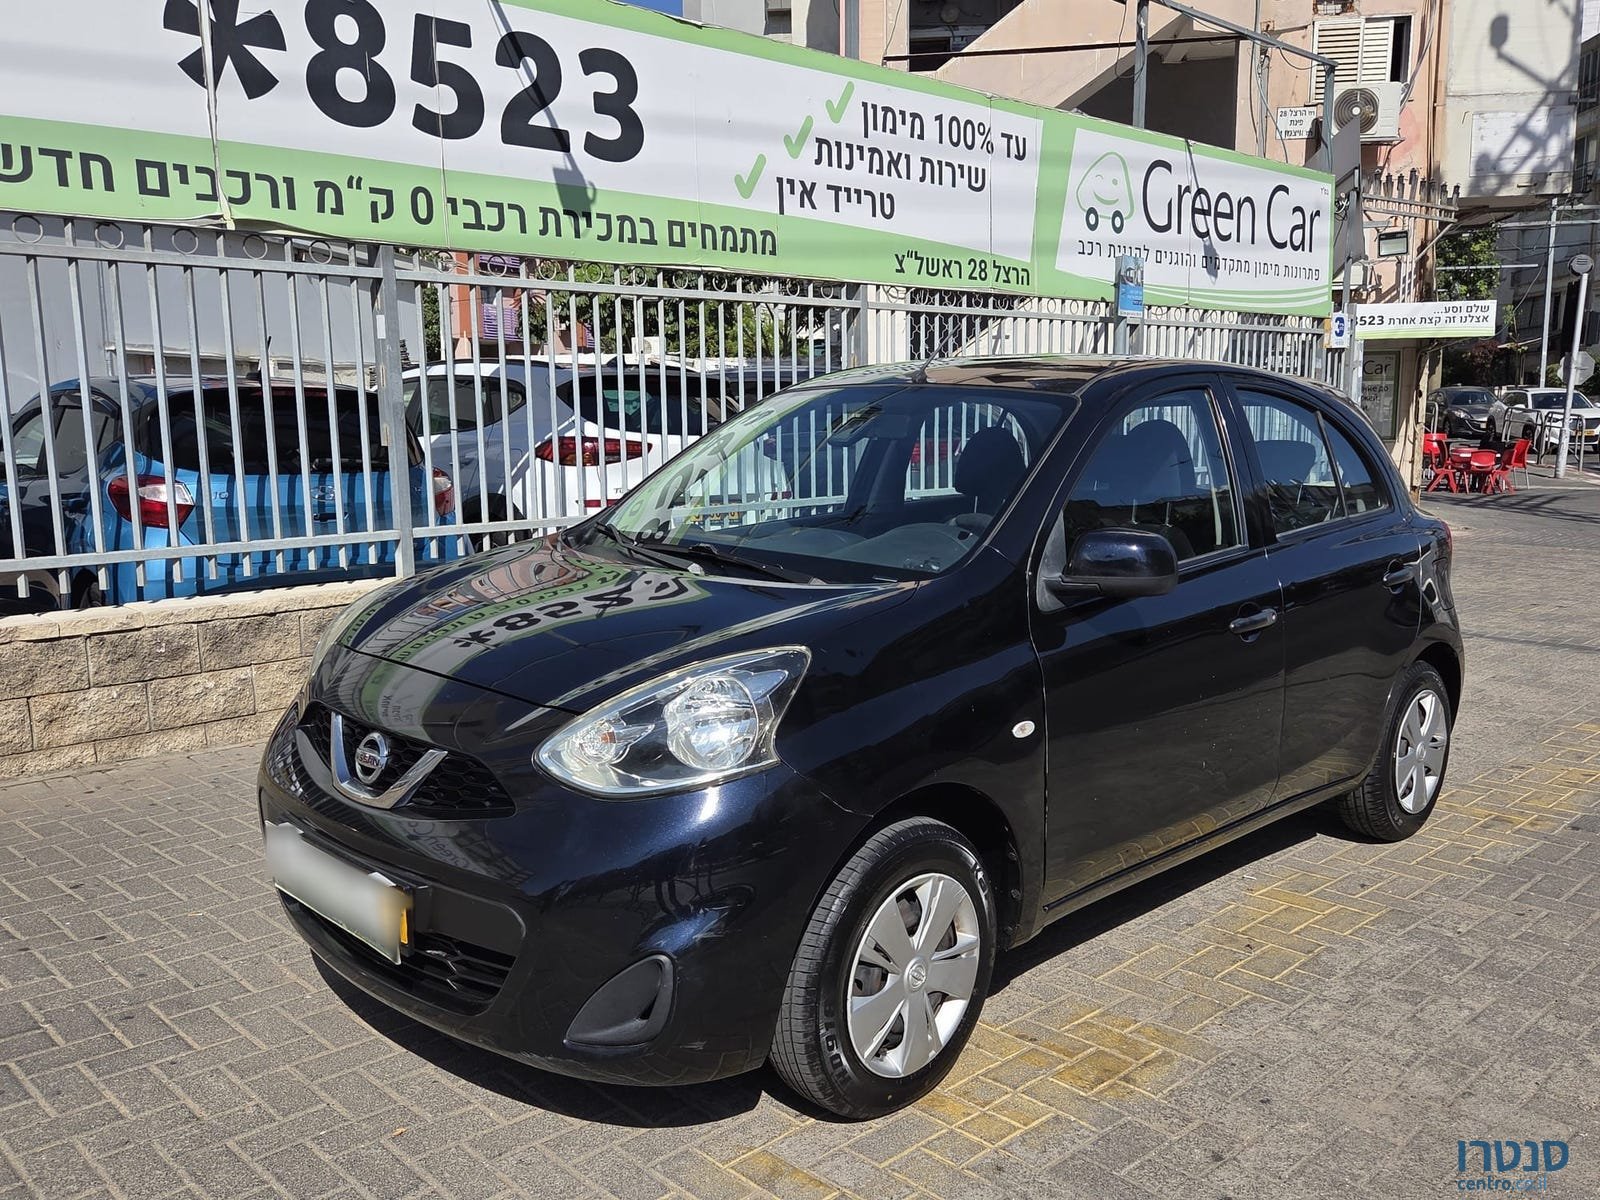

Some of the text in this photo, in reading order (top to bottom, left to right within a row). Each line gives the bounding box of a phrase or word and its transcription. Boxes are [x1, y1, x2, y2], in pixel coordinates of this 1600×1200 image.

[1289, 109, 1307, 117] הרצל
[861, 101, 1027, 162] עד 100% מימון
[814, 137, 987, 193] שירות ואמינות
[135, 158, 297, 212] ורכבים
[776, 176, 896, 220] טרייד אין
[1142, 159, 1321, 253] Green Car
[446, 197, 527, 235] רכבי
[538, 205, 658, 246] במכירת
[667, 219, 778, 256] מתמחים
[1077, 239, 1103, 258] רכב
[967, 257, 988, 282] 28
[1155, 249, 1197, 269] והוגנים
[1201, 254, 1250, 276] מתקדמים
[1254, 259, 1280, 279] מימון
[992, 259, 1031, 286] הרצל
[1282, 264, 1321, 282] פתרונות
[1459, 314, 1489, 324] אצלנו
[1465, 304, 1490, 313] שלם
[1388, 317, 1417, 326] אחרת
[1419, 317, 1442, 327] קצת
